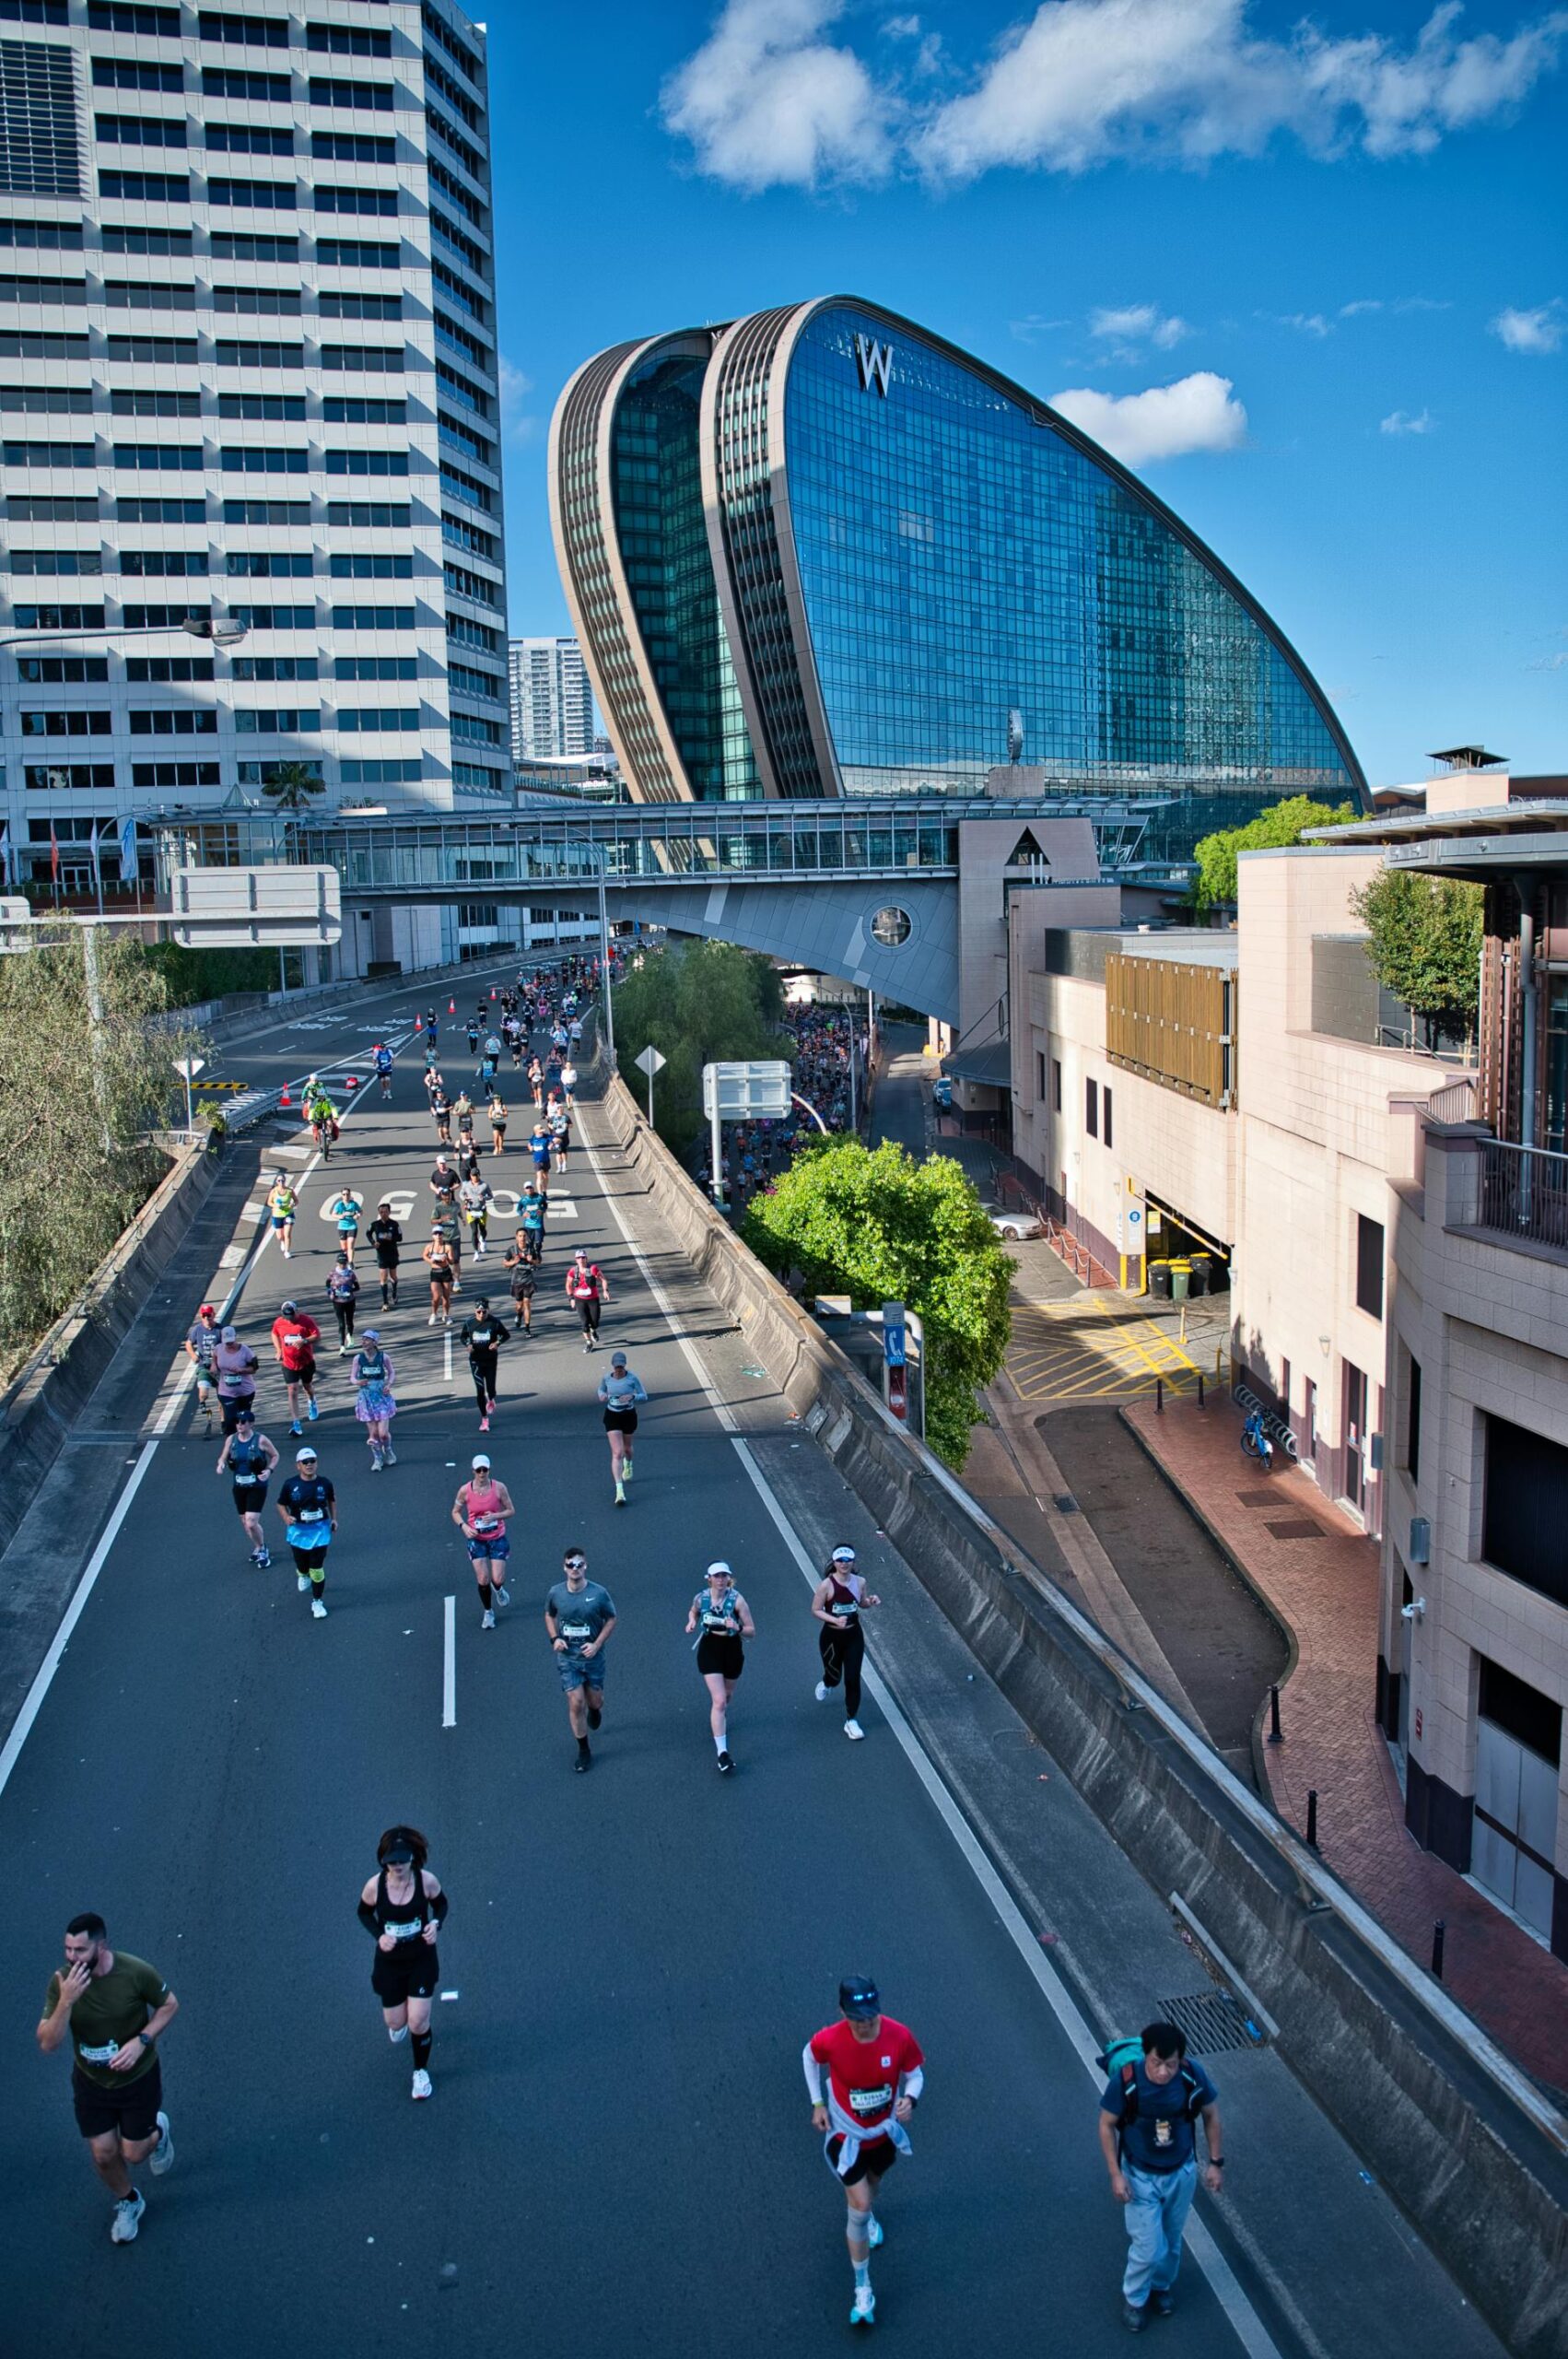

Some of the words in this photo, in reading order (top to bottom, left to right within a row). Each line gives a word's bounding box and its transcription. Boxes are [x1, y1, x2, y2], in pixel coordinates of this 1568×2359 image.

[856, 332, 894, 399] W
[319, 1190, 417, 1222] 50
[485, 1188, 579, 1219] 50
[889, 1356, 904, 1366] 1074
